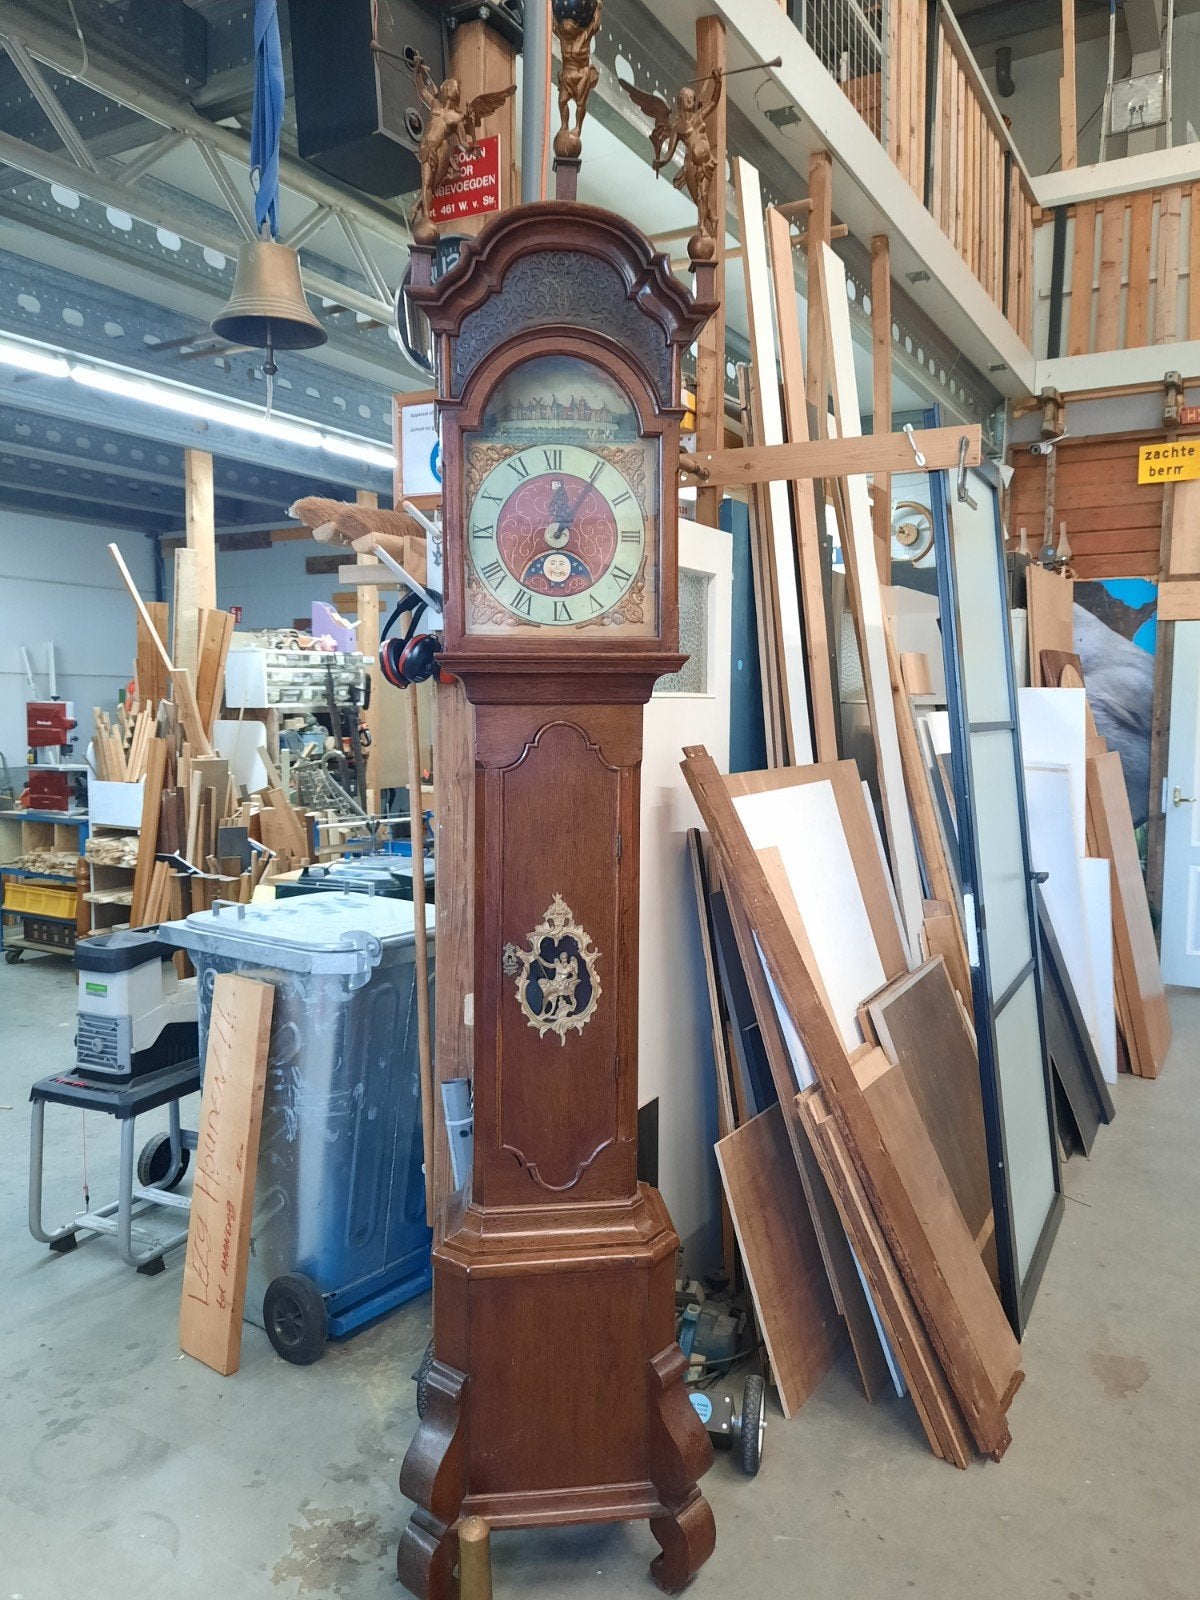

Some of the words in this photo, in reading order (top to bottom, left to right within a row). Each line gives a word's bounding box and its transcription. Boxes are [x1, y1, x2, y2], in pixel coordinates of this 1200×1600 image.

[434, 174, 496, 198] NBEVOEGDEN
[440, 203, 455, 215] 461
[458, 200, 469, 211] W.
[1144, 446, 1195, 461] zachte
